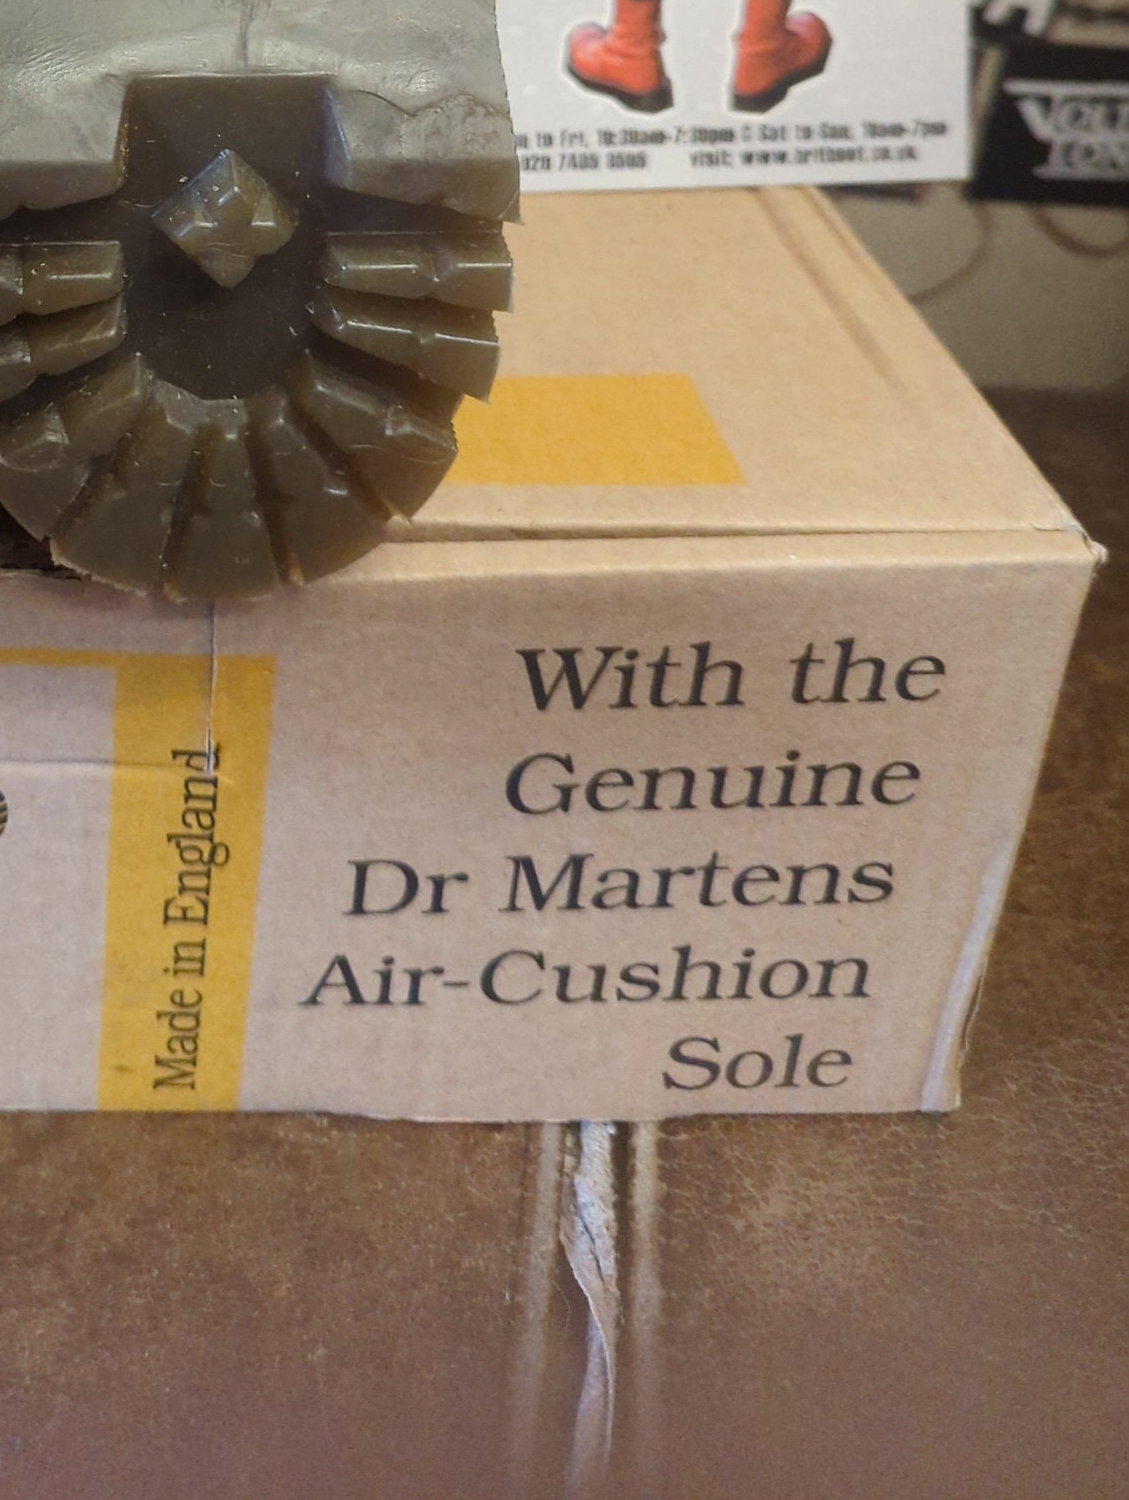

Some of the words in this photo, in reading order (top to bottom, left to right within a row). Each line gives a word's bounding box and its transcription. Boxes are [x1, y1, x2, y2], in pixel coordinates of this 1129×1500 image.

[517, 643, 746, 711] With
[788, 637, 947, 705] the
[505, 750, 923, 816] Genuine
[163, 743, 230, 927] England
[343, 859, 469, 916] Dr
[498, 851, 896, 915] Martens
[163, 937, 206, 977] in
[298, 944, 872, 1008] Air-Cushion
[153, 988, 202, 1091] Made
[661, 1033, 854, 1090] Sole
